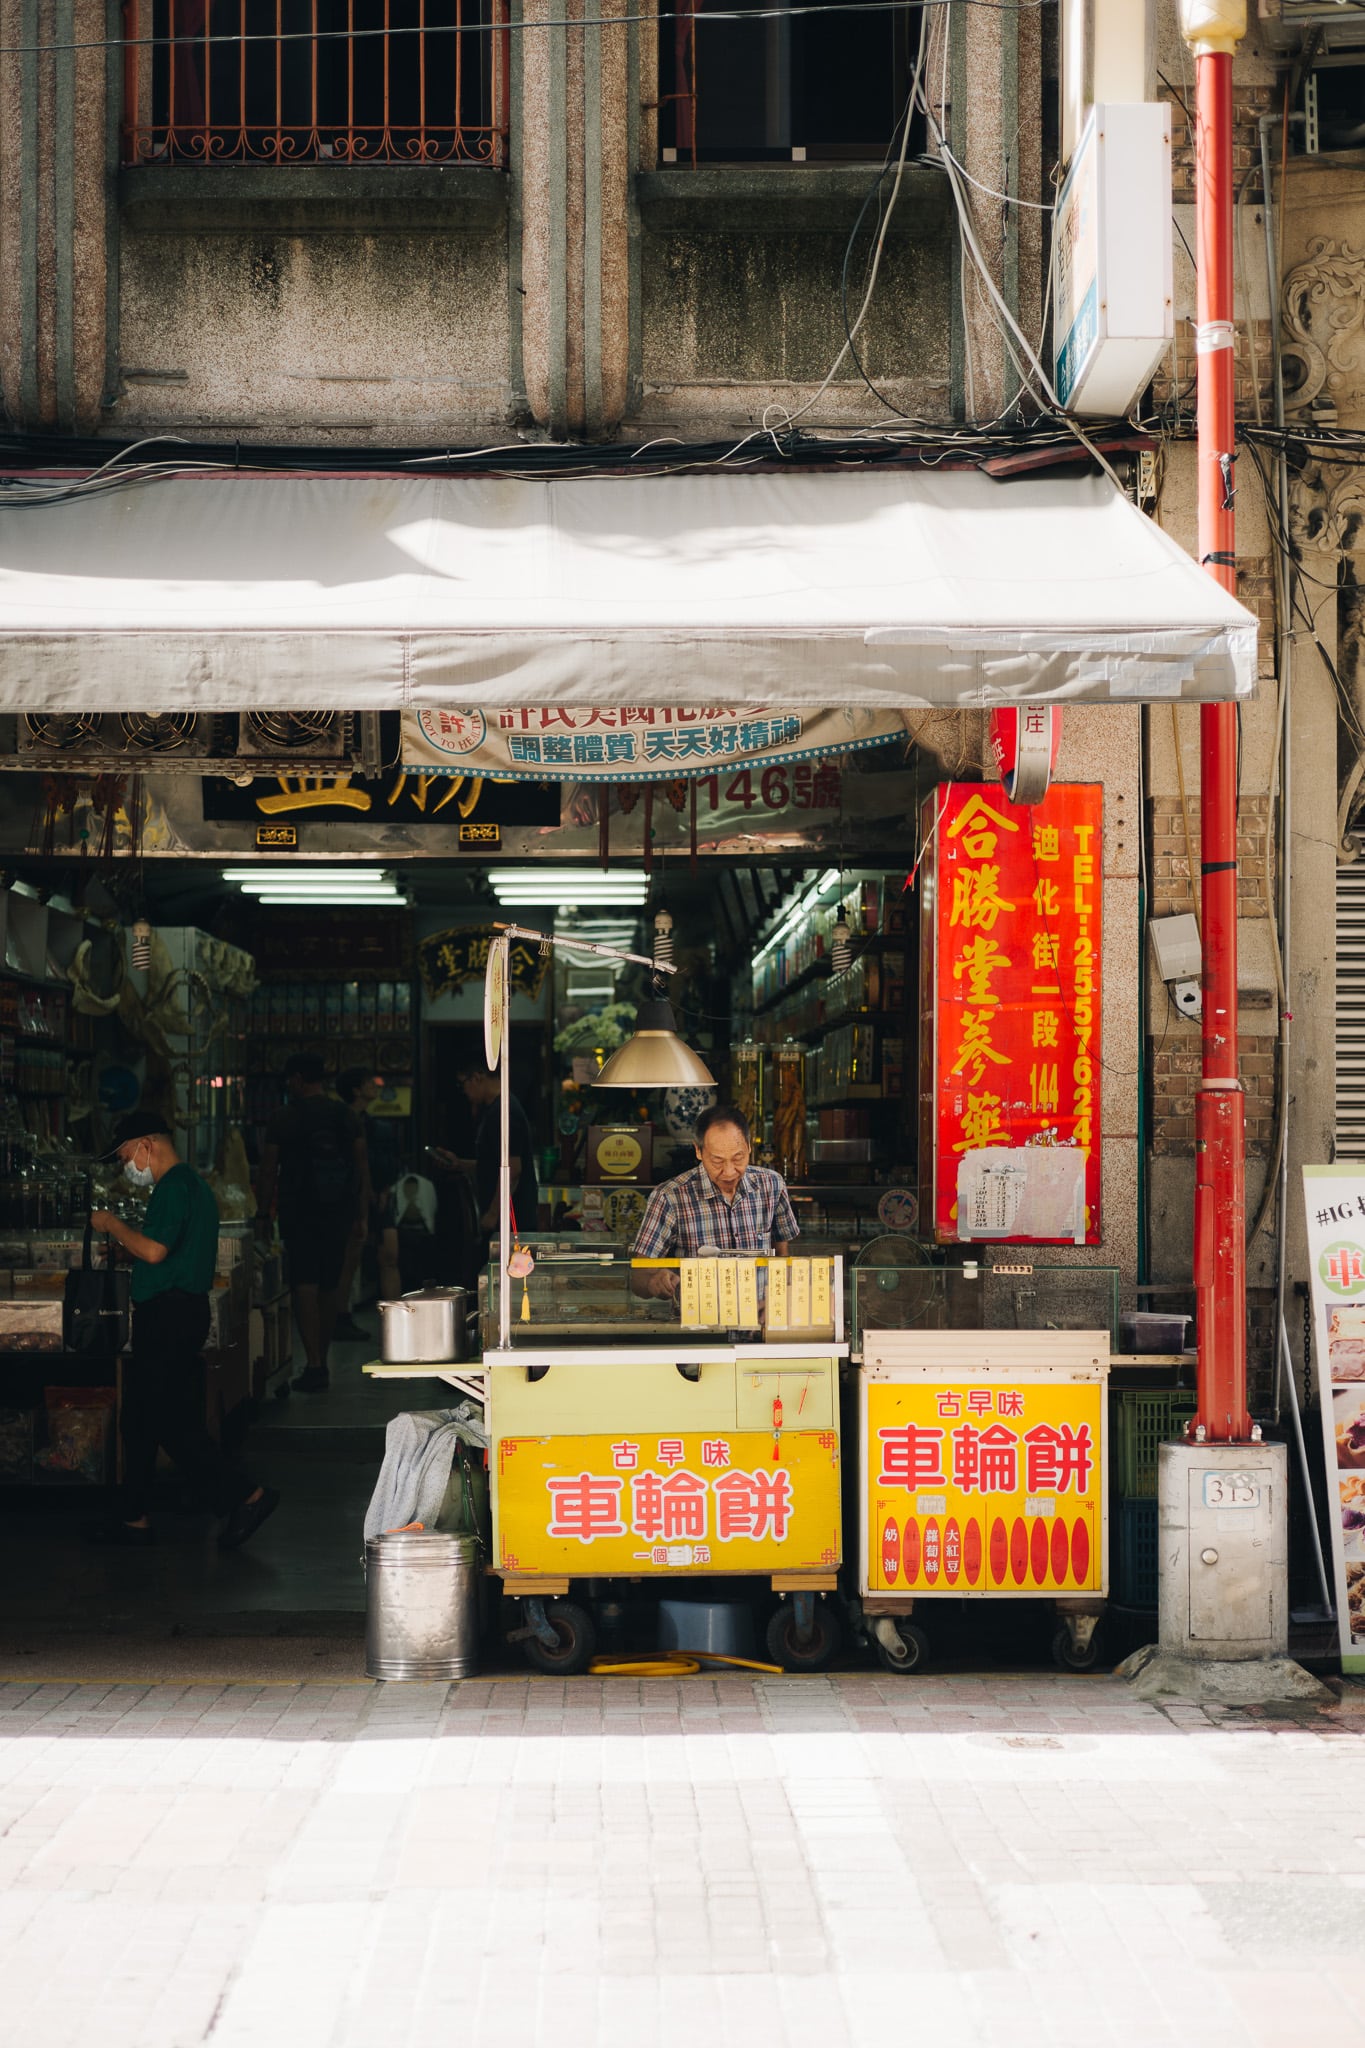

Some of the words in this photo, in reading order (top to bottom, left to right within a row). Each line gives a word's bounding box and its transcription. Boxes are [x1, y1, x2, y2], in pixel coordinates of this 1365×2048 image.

[441, 738, 455, 749] TO
[458, 714, 481, 750] HEALTH
[509, 732, 636, 764] 調整體質
[644, 715, 803, 760] 天天好精神
[947, 794, 1019, 1221] 合勝堂蔘藥
[1316, 1202, 1353, 1227] #IG
[937, 1391, 1024, 1417] 古早味
[612, 1440, 730, 1467] 古早味
[878, 1424, 1092, 1494] 車輪餅
[547, 1471, 791, 1540] 車輪餅
[634, 1546, 711, 1565] 一個元
[884, 1528, 898, 1573] 奶油
[925, 1528, 939, 1574] 蘿蔔絲
[945, 1528, 959, 1574] 大紅豆
